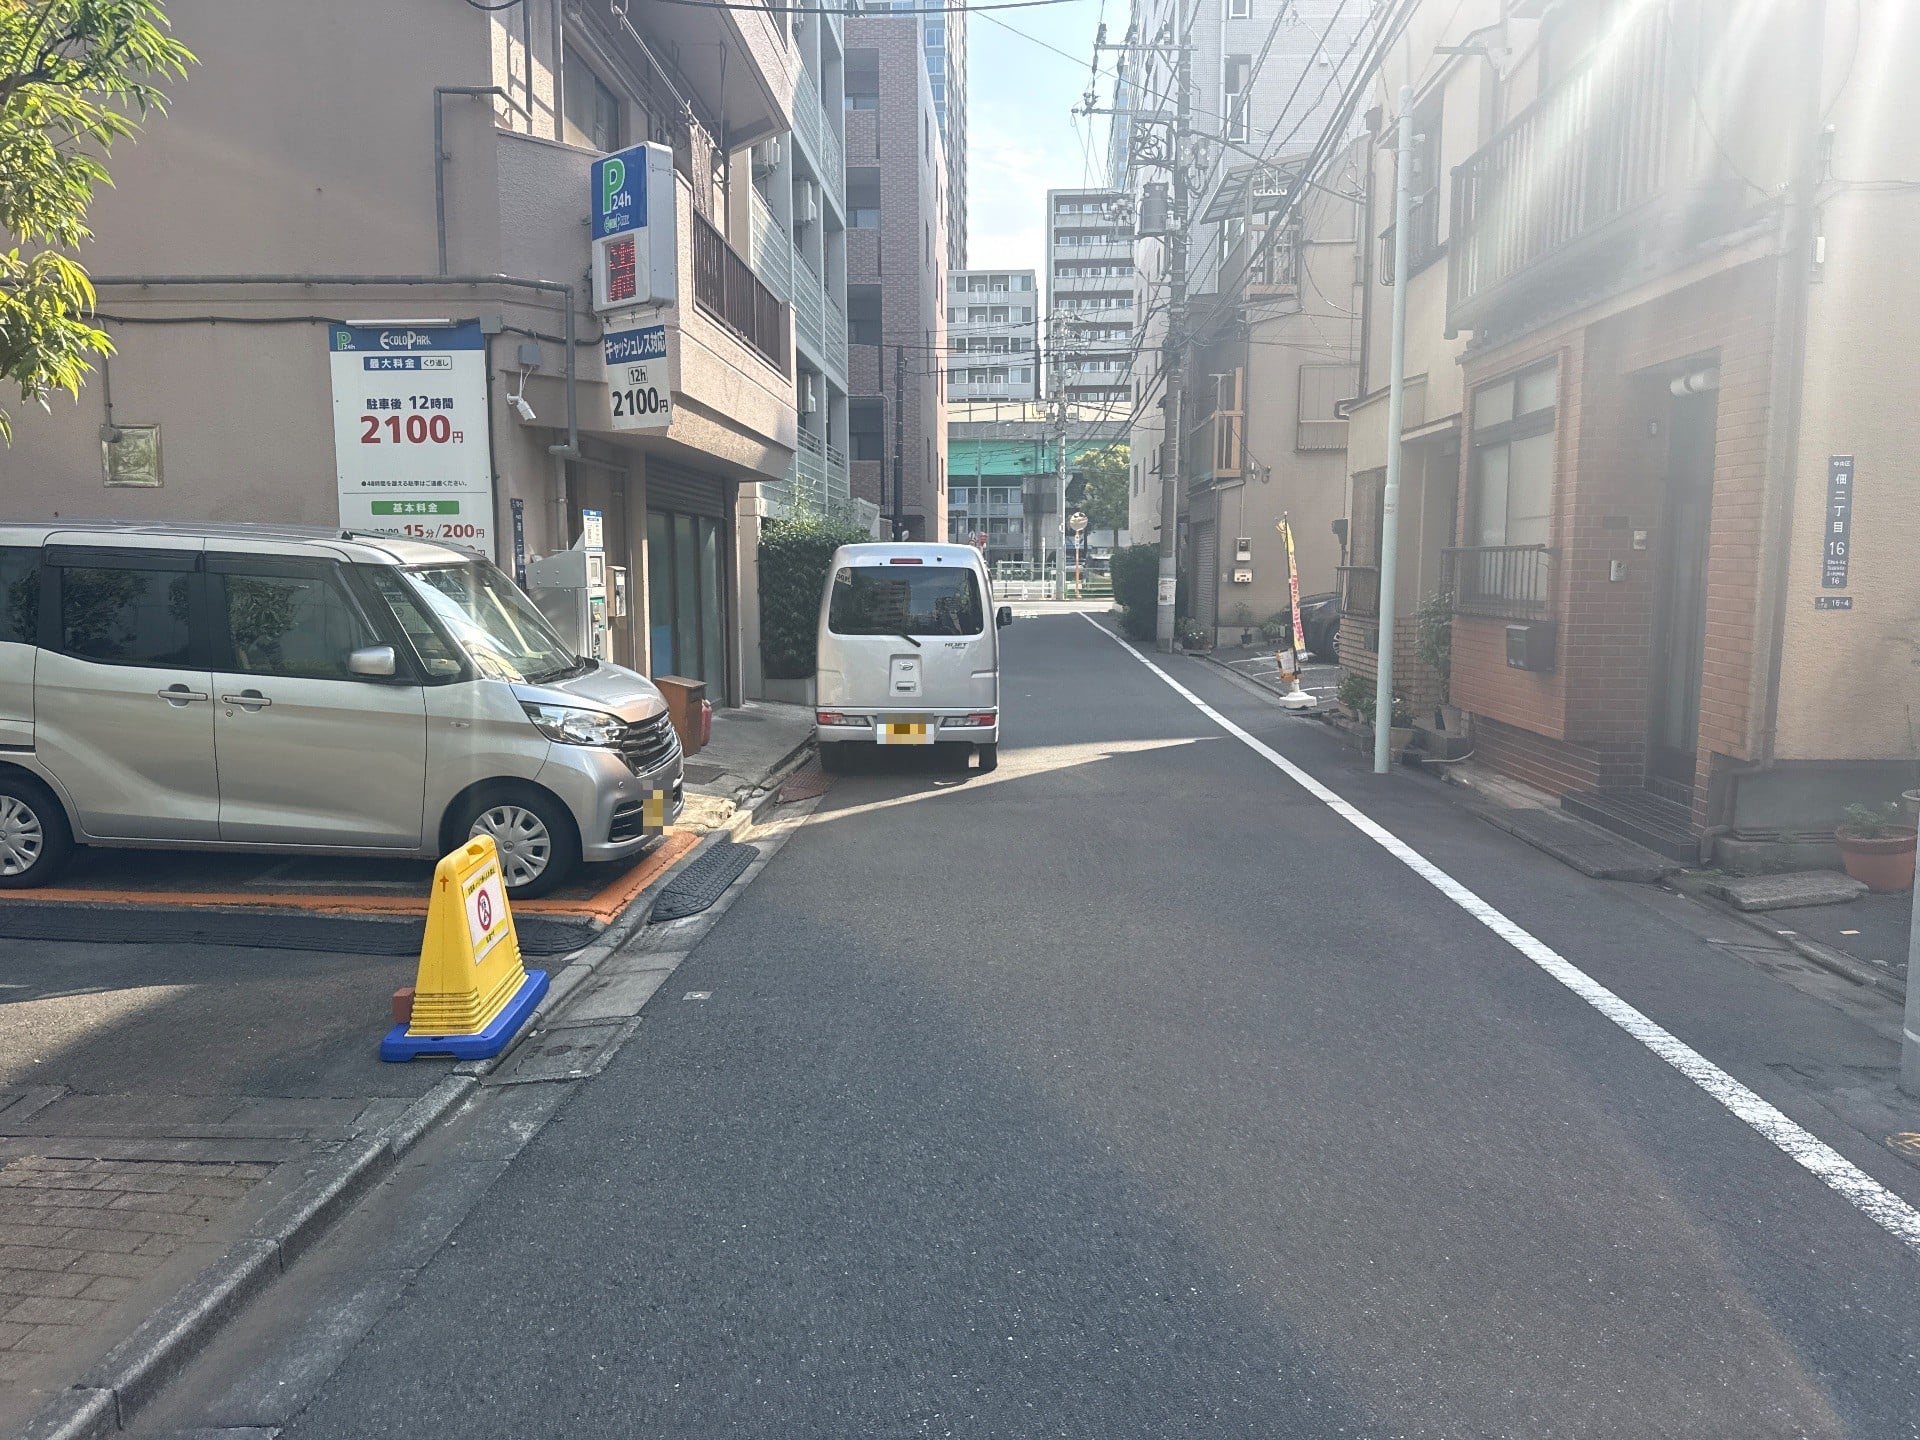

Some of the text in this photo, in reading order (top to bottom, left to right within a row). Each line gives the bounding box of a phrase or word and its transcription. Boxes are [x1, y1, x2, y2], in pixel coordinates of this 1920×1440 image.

[602, 158, 626, 215] P
[612, 190, 632, 212] 24h
[605, 330, 667, 360] キャッシュレス対応
[369, 358, 415, 369] 最大料金
[630, 368, 647, 383] 12h
[366, 395, 454, 410] 駐車後 12時間
[613, 386, 668, 417] 2100円
[360, 414, 464, 444] 2100円
[392, 502, 438, 514] 基本料金
[1833, 473, 1847, 533] 佃二丁目
[1829, 541, 1846, 556] 16
[1831, 577, 1840, 585] 16
